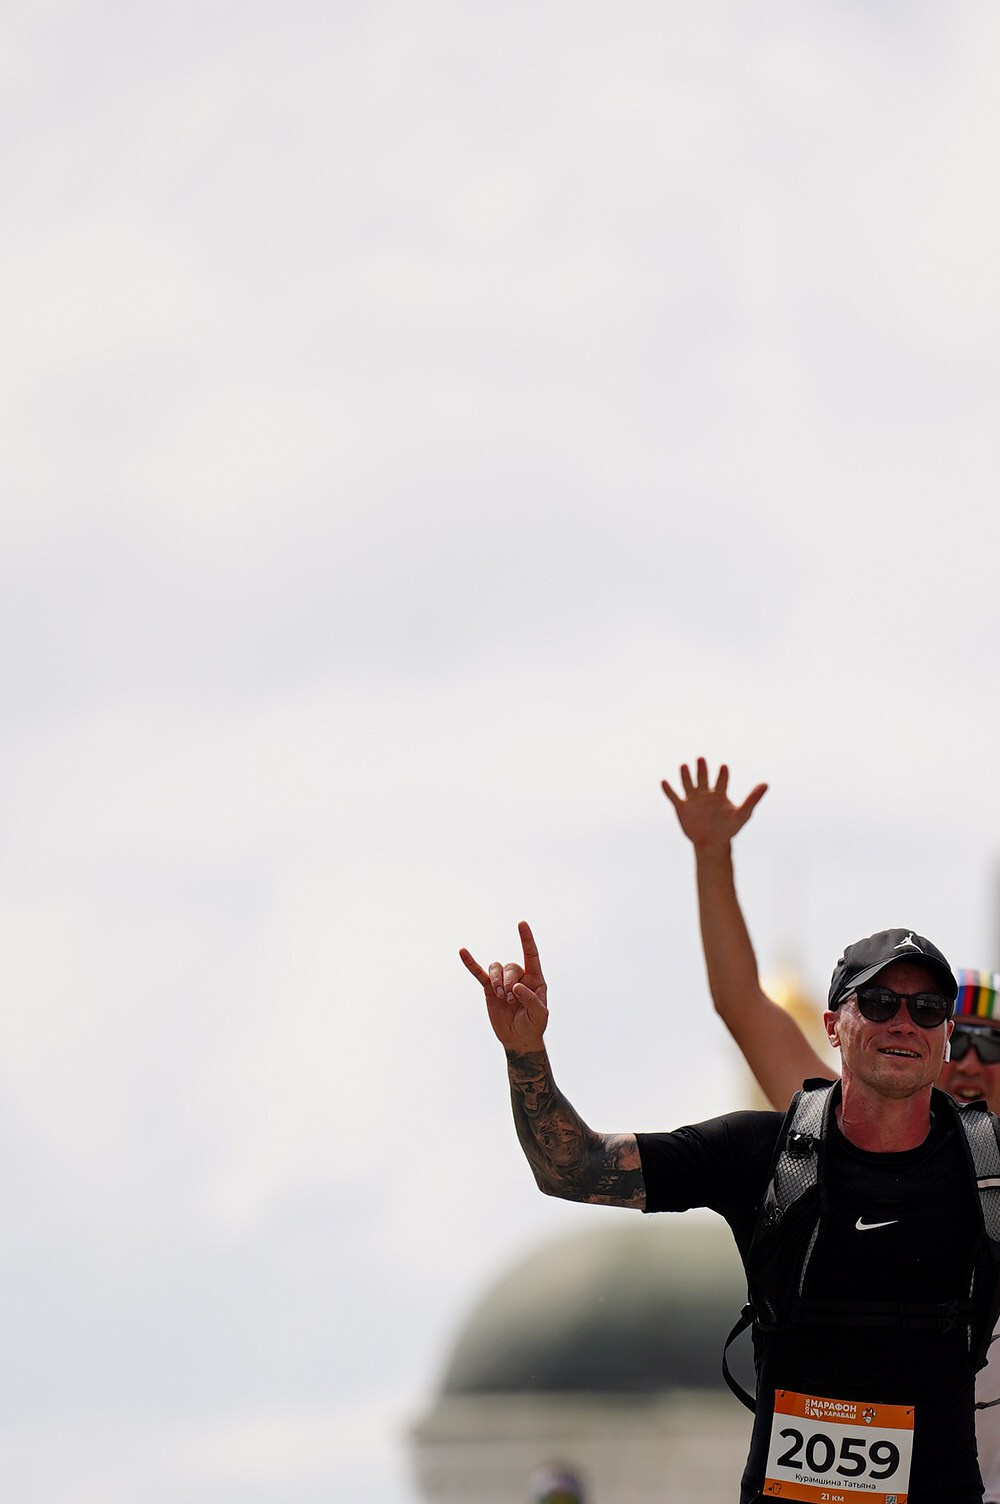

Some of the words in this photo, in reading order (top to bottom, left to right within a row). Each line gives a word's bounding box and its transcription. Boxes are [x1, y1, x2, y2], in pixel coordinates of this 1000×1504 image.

[810, 1399, 857, 1413] МАРАФОН
[823, 1408, 856, 1420] КАРАБАШ
[777, 1428, 900, 1480] 2059
[795, 1473, 842, 1487] Курамшина
[843, 1480, 876, 1491] Татьяна
[821, 1492, 830, 1501] 21
